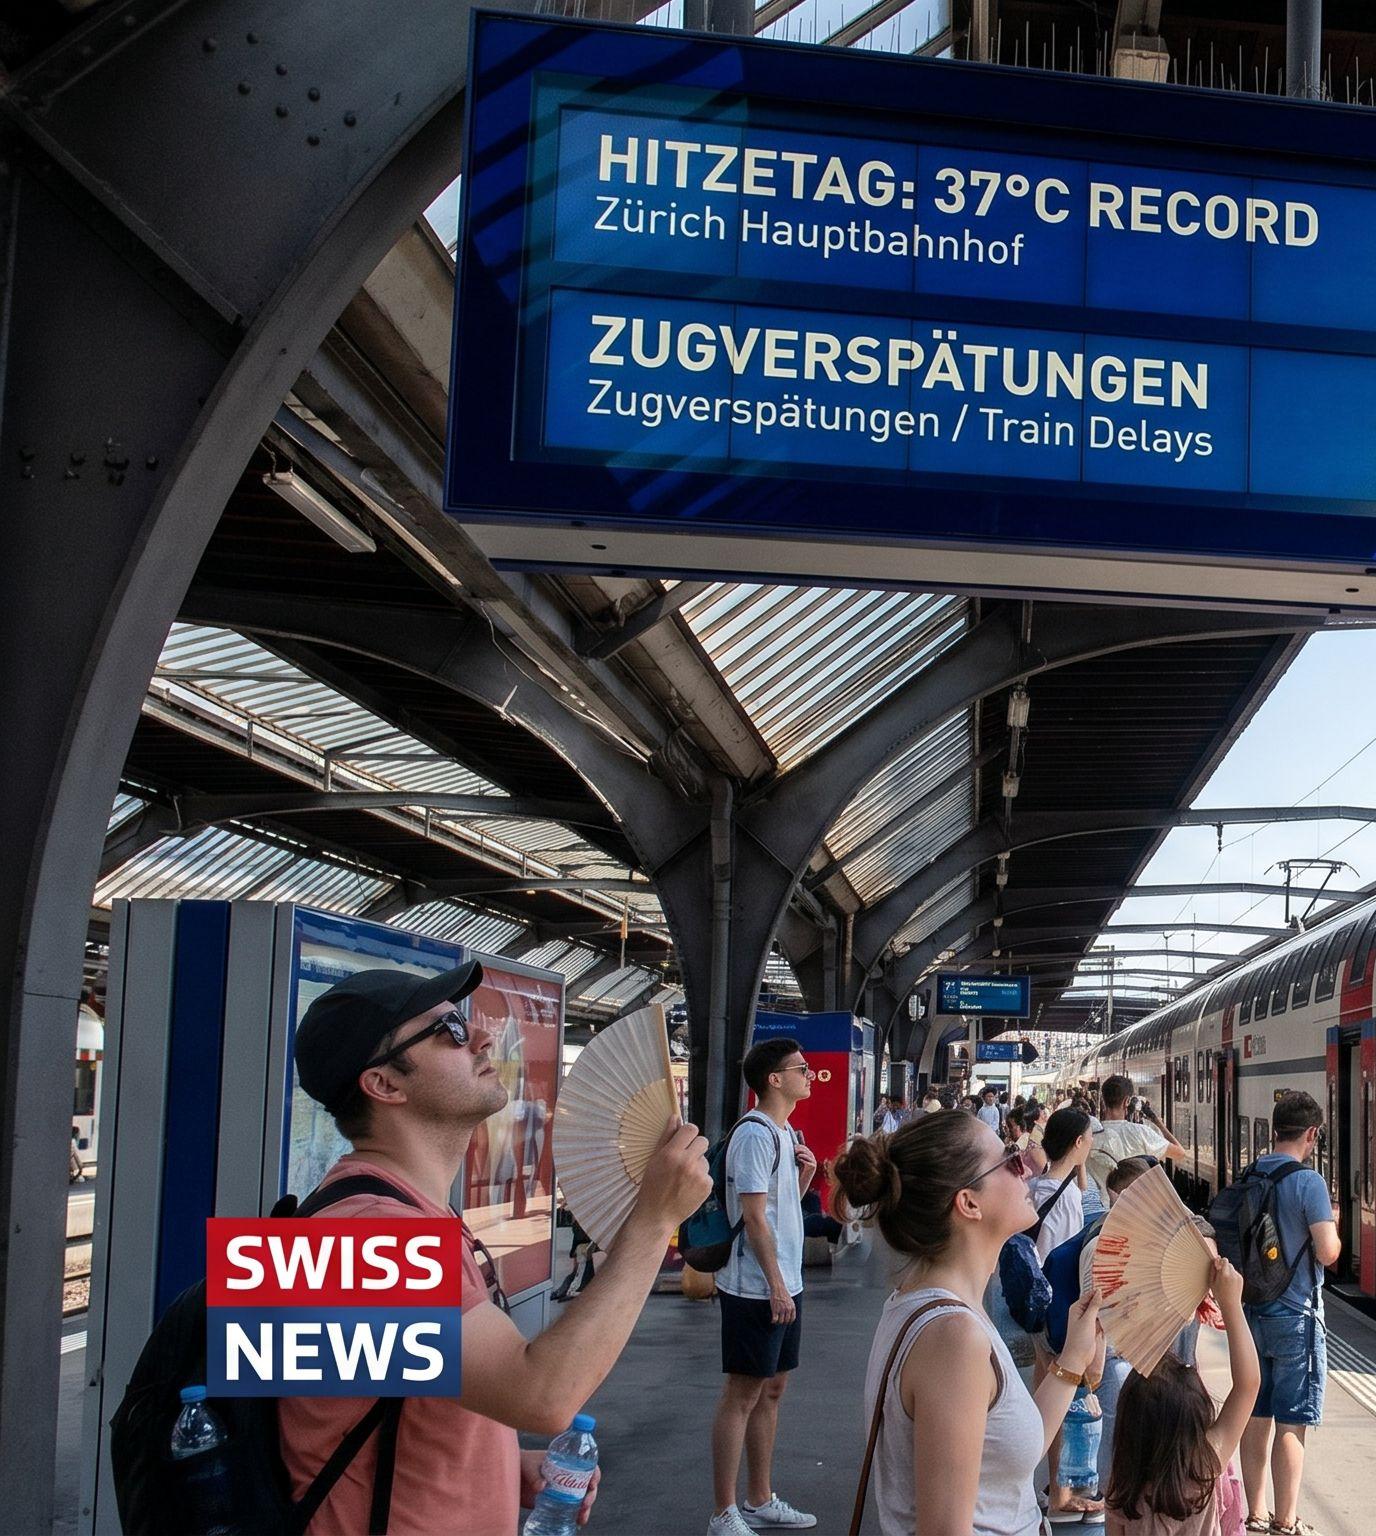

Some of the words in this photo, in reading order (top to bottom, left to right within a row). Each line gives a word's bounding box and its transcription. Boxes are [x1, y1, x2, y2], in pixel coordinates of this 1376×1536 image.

[595, 196, 725, 239] Zürich
[743, 210, 1024, 266] Hauptbahnhof
[599, 135, 914, 209] HITZETAG:
[935, 168, 1069, 223] 37°C
[1090, 183, 1319, 247] RECORD
[590, 315, 1208, 410] ZUGVERSPÄTUNGEN
[588, 379, 939, 443] Zugverspätungen
[952, 404, 968, 441] /
[980, 408, 1074, 446] Train
[1091, 416, 1213, 463] Delays
